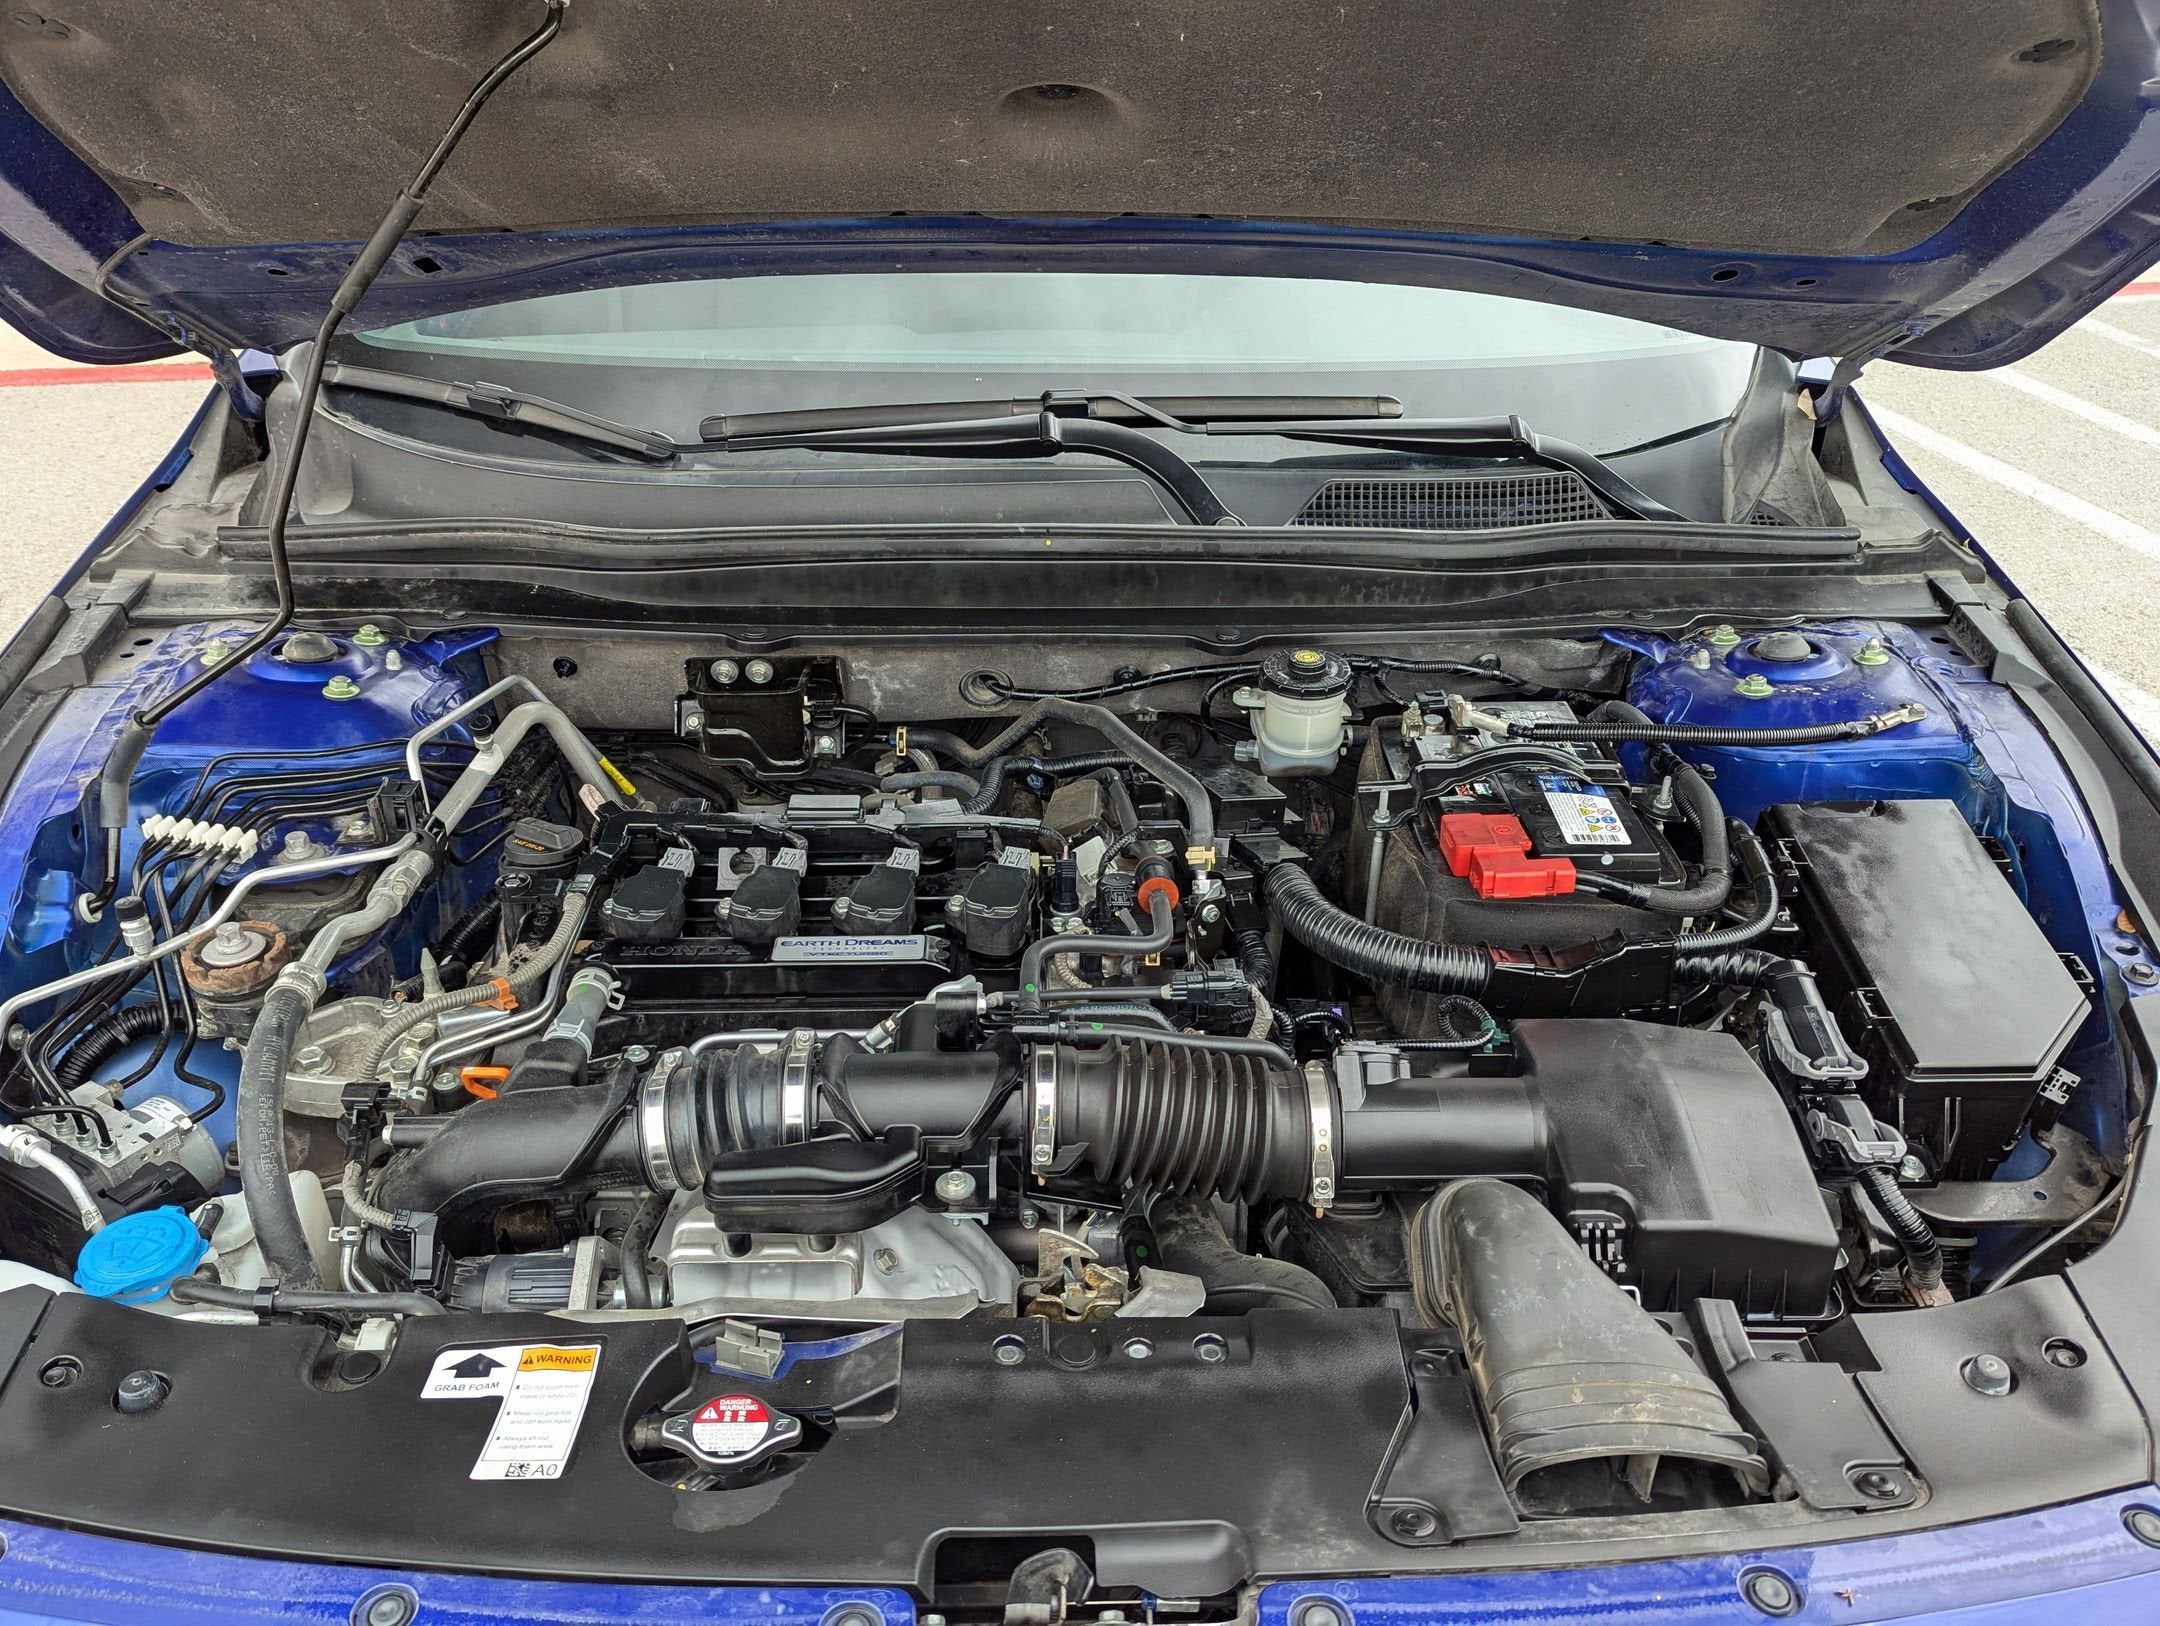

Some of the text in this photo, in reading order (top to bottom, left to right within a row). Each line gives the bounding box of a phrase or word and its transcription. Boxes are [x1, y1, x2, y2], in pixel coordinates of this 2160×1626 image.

[780, 938, 918, 947] EARTH DREAMS
[619, 944, 751, 957] HONDA
[536, 1354, 593, 1365] WARNING
[434, 1381, 500, 1392] GRAB FOAM
[530, 1463, 559, 1477] A0
